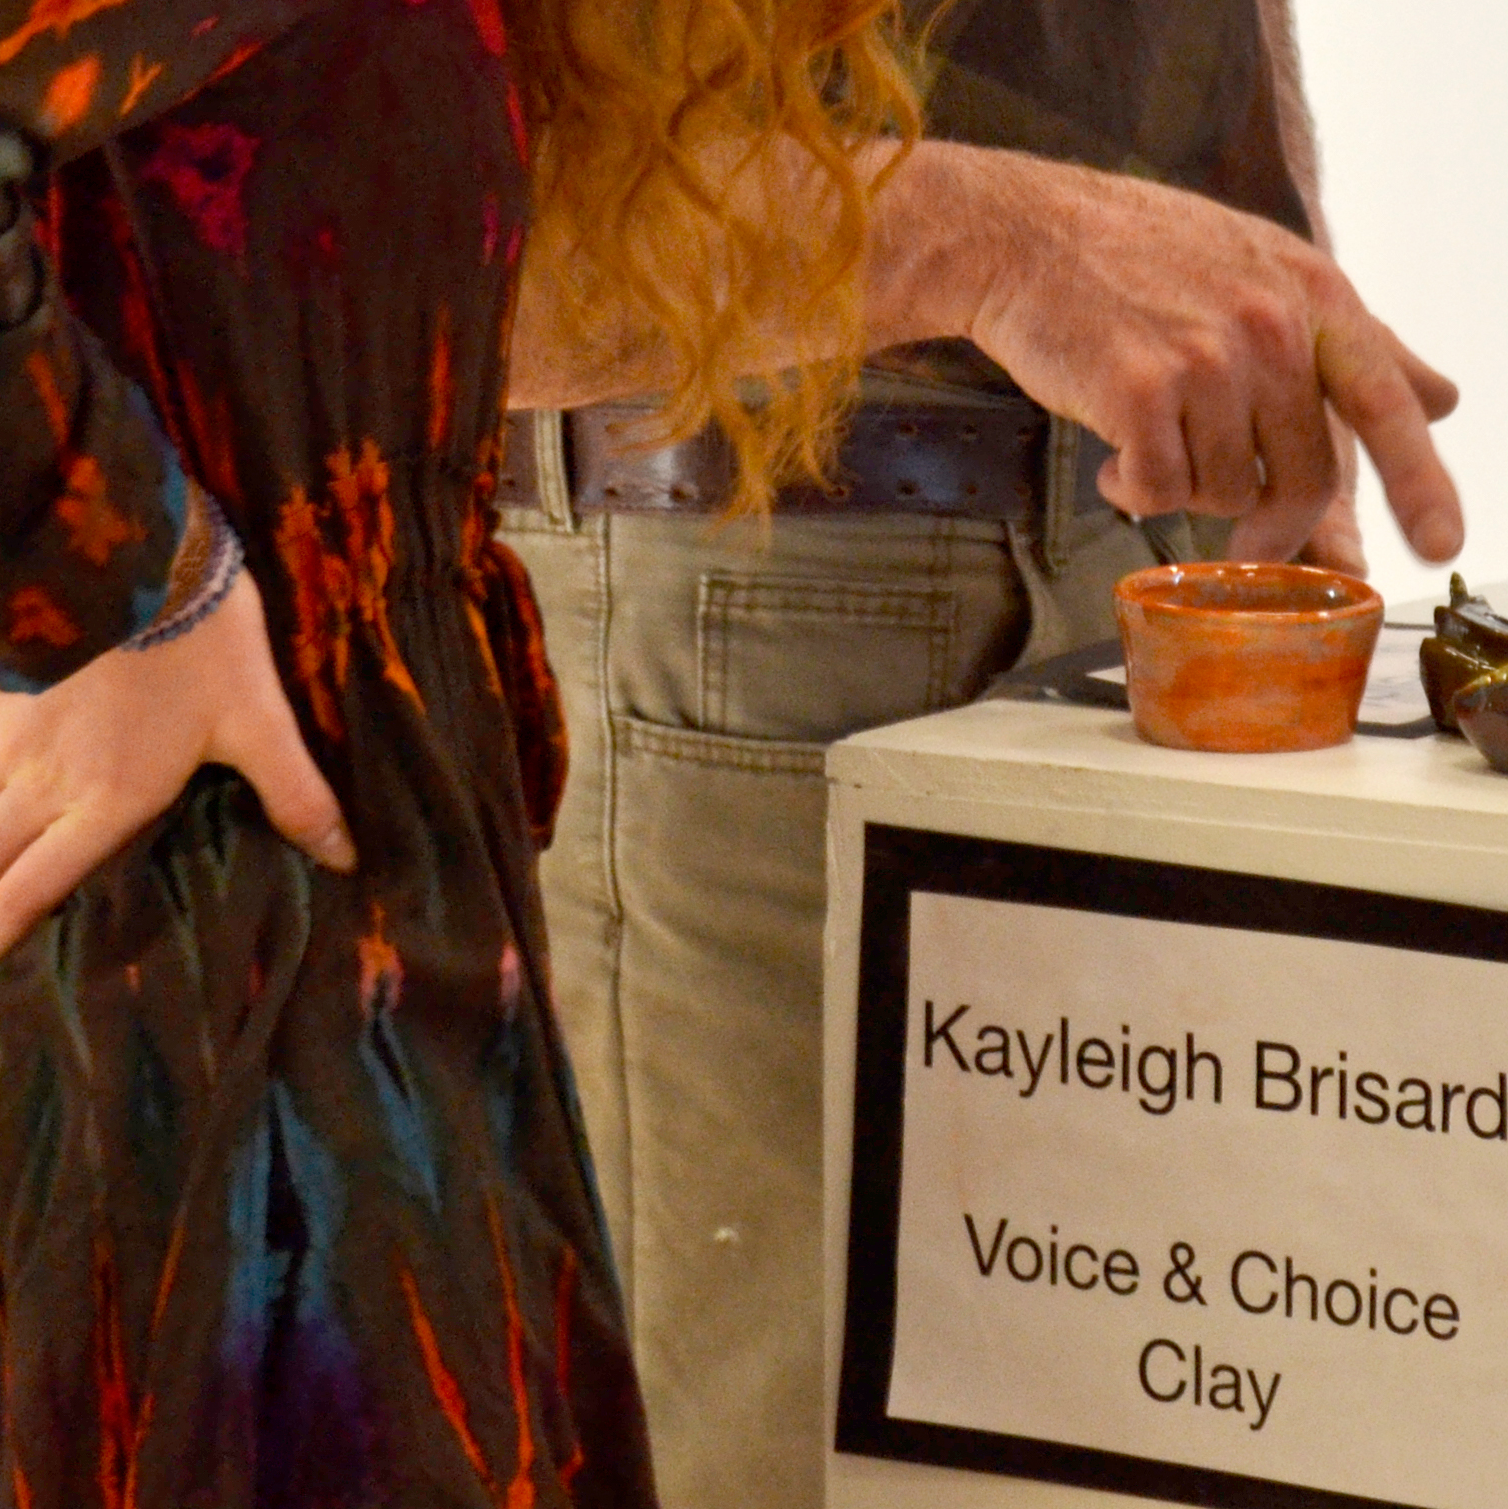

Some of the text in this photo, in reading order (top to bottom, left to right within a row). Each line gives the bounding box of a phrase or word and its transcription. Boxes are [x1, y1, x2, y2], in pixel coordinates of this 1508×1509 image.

[923, 999, 1508, 1142] Kayleigh Brisard
[962, 1212, 1461, 1342] Voice & Choice
[1137, 1337, 1282, 1432] Clay
